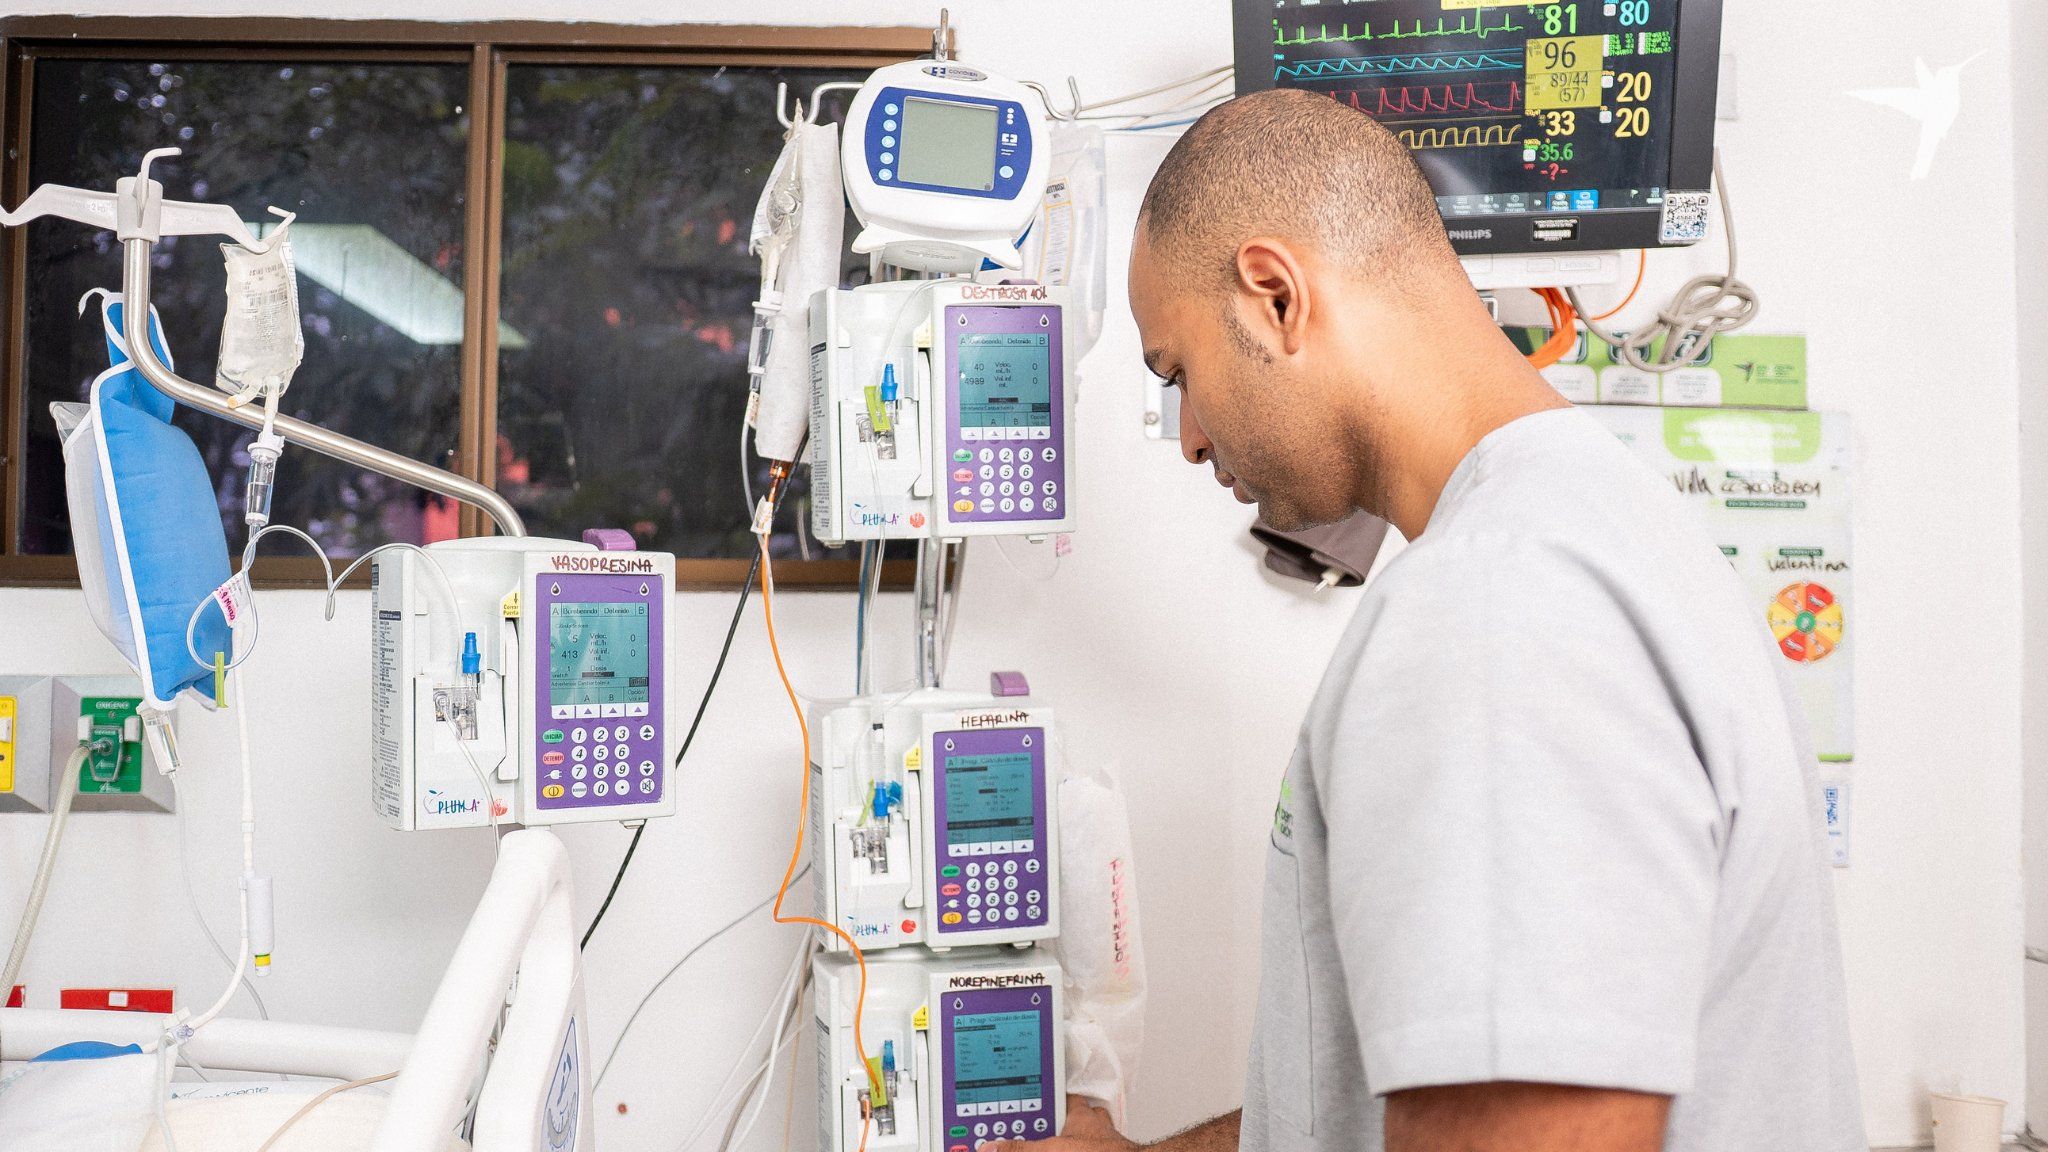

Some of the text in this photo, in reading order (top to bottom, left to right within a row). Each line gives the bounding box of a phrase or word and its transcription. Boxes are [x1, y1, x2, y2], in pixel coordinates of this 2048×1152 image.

[1619, 0, 1649, 26] 80
[1544, 4, 1577, 35] 81
[1545, 41, 1576, 69] 96
[1551, 71, 1589, 88] 89/44
[1616, 71, 1652, 103] 20
[1559, 87, 1586, 102] (57)
[1546, 110, 1575, 136] 33
[1615, 106, 1650, 138] 20
[1540, 142, 1574, 162] 35.6
[1448, 229, 1492, 240] PHILIPS
[961, 285, 1027, 301] DEXTROSA
[1007, 337, 1032, 345] Detenido
[1039, 337, 1045, 345] B
[984, 451, 990, 460] 1
[1003, 451, 1010, 460] 2
[1023, 451, 1030, 460] 3
[984, 467, 990, 476] 4
[1003, 467, 1010, 476] 5
[1023, 467, 1030, 476] 6
[984, 484, 990, 494] 7
[1003, 484, 1010, 493] 8
[1023, 484, 1030, 493] 9
[1004, 501, 1011, 510] 0
[551, 555, 653, 573] VASOPRESINA
[552, 607, 559, 615] A
[638, 607, 645, 615] B
[572, 634, 578, 643] 5
[561, 650, 578, 659] 413
[583, 694, 590, 702] A
[960, 710, 1030, 729] HEPARINA
[576, 731, 582, 741] 1
[597, 729, 605, 740] 2
[618, 729, 626, 739] 3
[576, 748, 583, 759] 4
[597, 748, 605, 758] 5
[618, 747, 626, 757] 6
[575, 767, 583, 777] 7
[597, 766, 605, 776] 8
[618, 764, 626, 774] 9
[597, 783, 605, 794] 0
[438, 799, 465, 814] PLUM
[989, 864, 996, 873] 2
[1007, 863, 1014, 872] 3
[971, 881, 977, 889] 4
[989, 880, 996, 889] 5
[1007, 879, 1014, 888] 6
[971, 897, 977, 905] 7
[989, 896, 996, 904] 8
[1008, 894, 1015, 903] 9
[990, 911, 997, 920] 0
[949, 972, 1045, 988] NOREPINEFRINA
[979, 1126, 984, 1134] 1
[997, 1124, 1004, 1133] 2
[1015, 1122, 1022, 1132] 3
